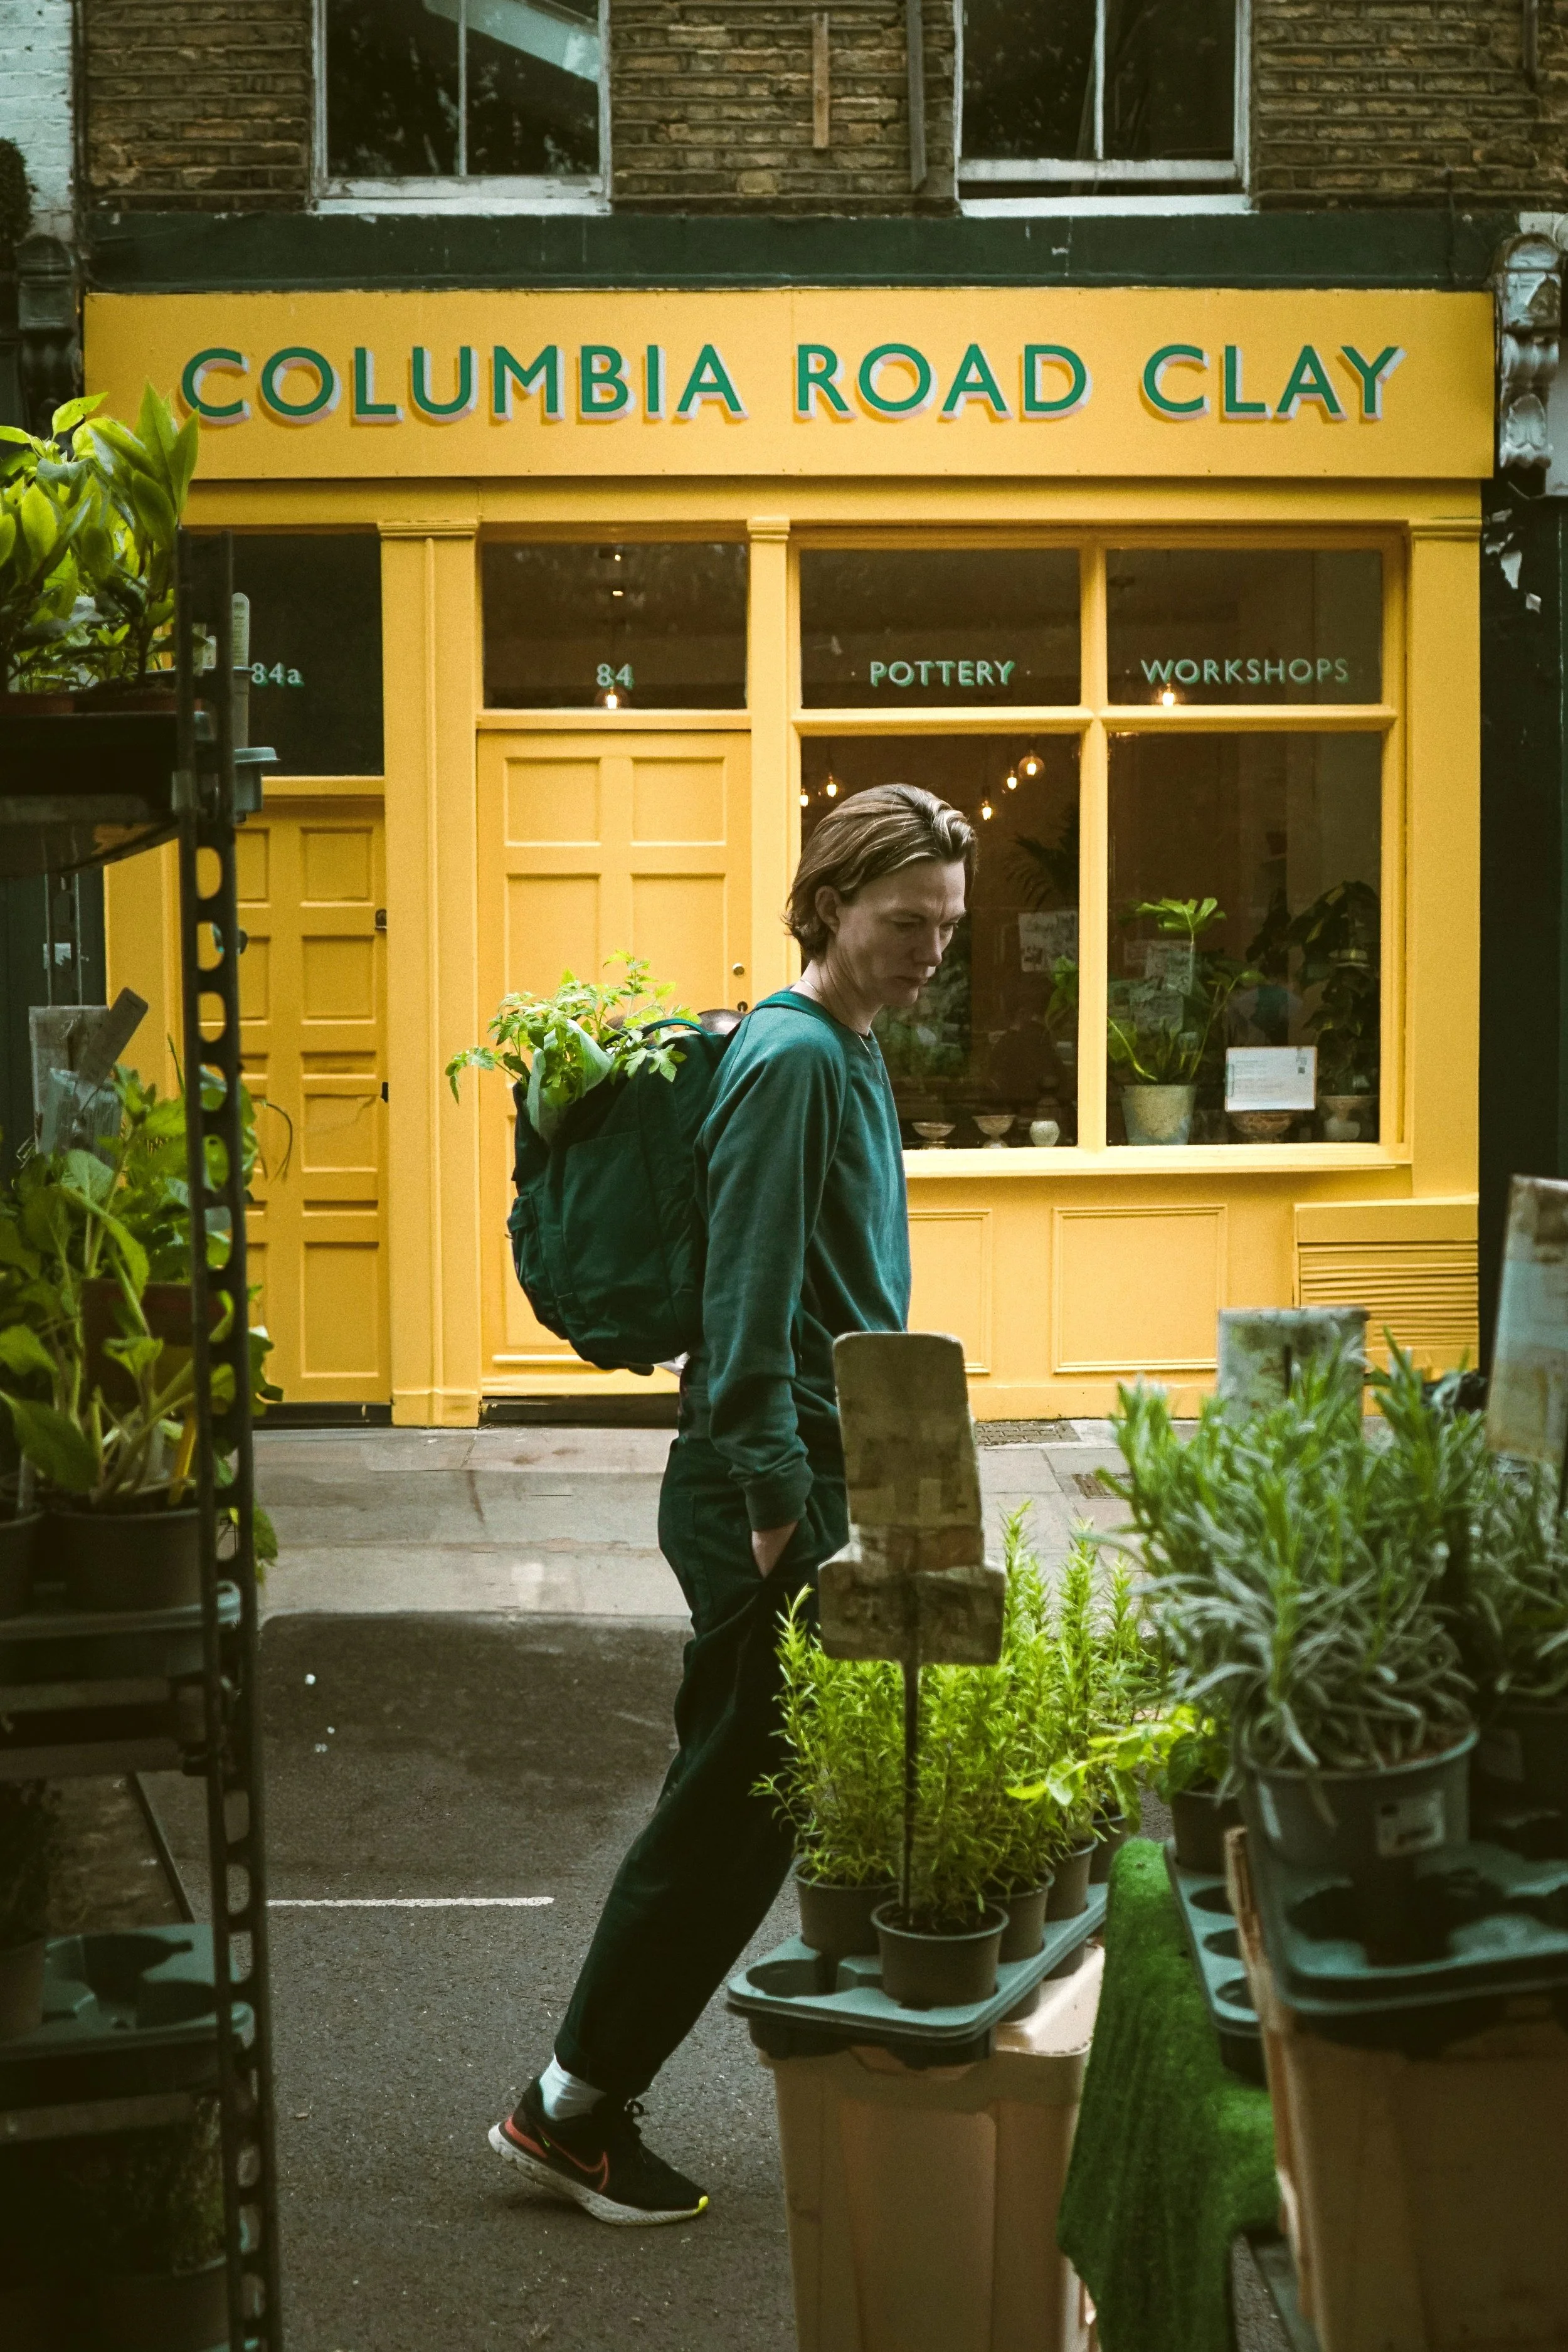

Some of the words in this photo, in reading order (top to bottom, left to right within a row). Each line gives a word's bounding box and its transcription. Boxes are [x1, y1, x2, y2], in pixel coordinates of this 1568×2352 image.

[181, 345, 748, 424] COLUMBIA
[796, 344, 1093, 421] ROAD
[1141, 344, 1406, 421] CLAY
[252, 662, 304, 687] 84a
[596, 663, 633, 690] 84
[870, 660, 1015, 687] POTTERY
[1141, 659, 1348, 685] WORKSHOPS
